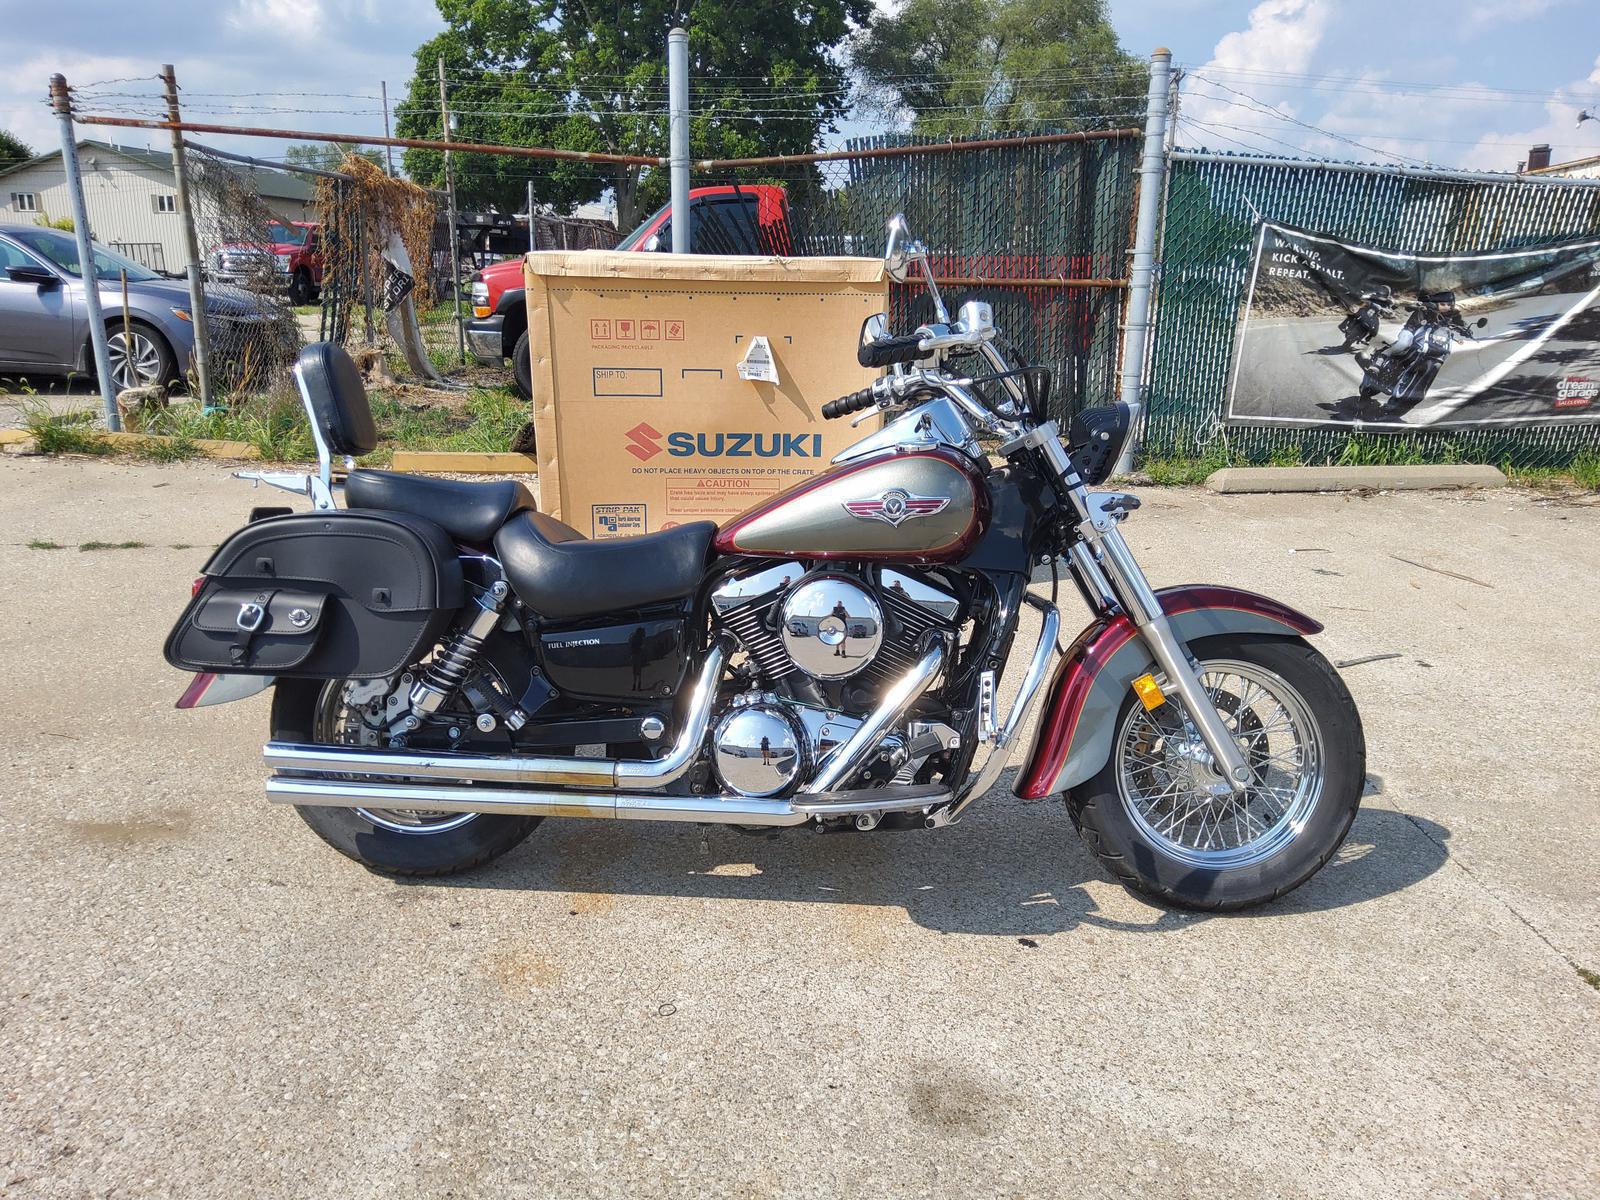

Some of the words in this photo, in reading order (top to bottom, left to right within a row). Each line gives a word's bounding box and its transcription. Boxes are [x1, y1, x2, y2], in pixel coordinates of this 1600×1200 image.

[1274, 238, 1305, 254] WAK
[1272, 252, 1298, 264] KICK
[1269, 267, 1311, 279] REPEAT.
[596, 370, 614, 379] SHIP
[1556, 378, 1595, 390] dream
[1557, 389, 1599, 400] garage
[667, 431, 822, 458] SUZUKI
[705, 479, 750, 488] CAUTION
[565, 638, 600, 648] INJECTION
